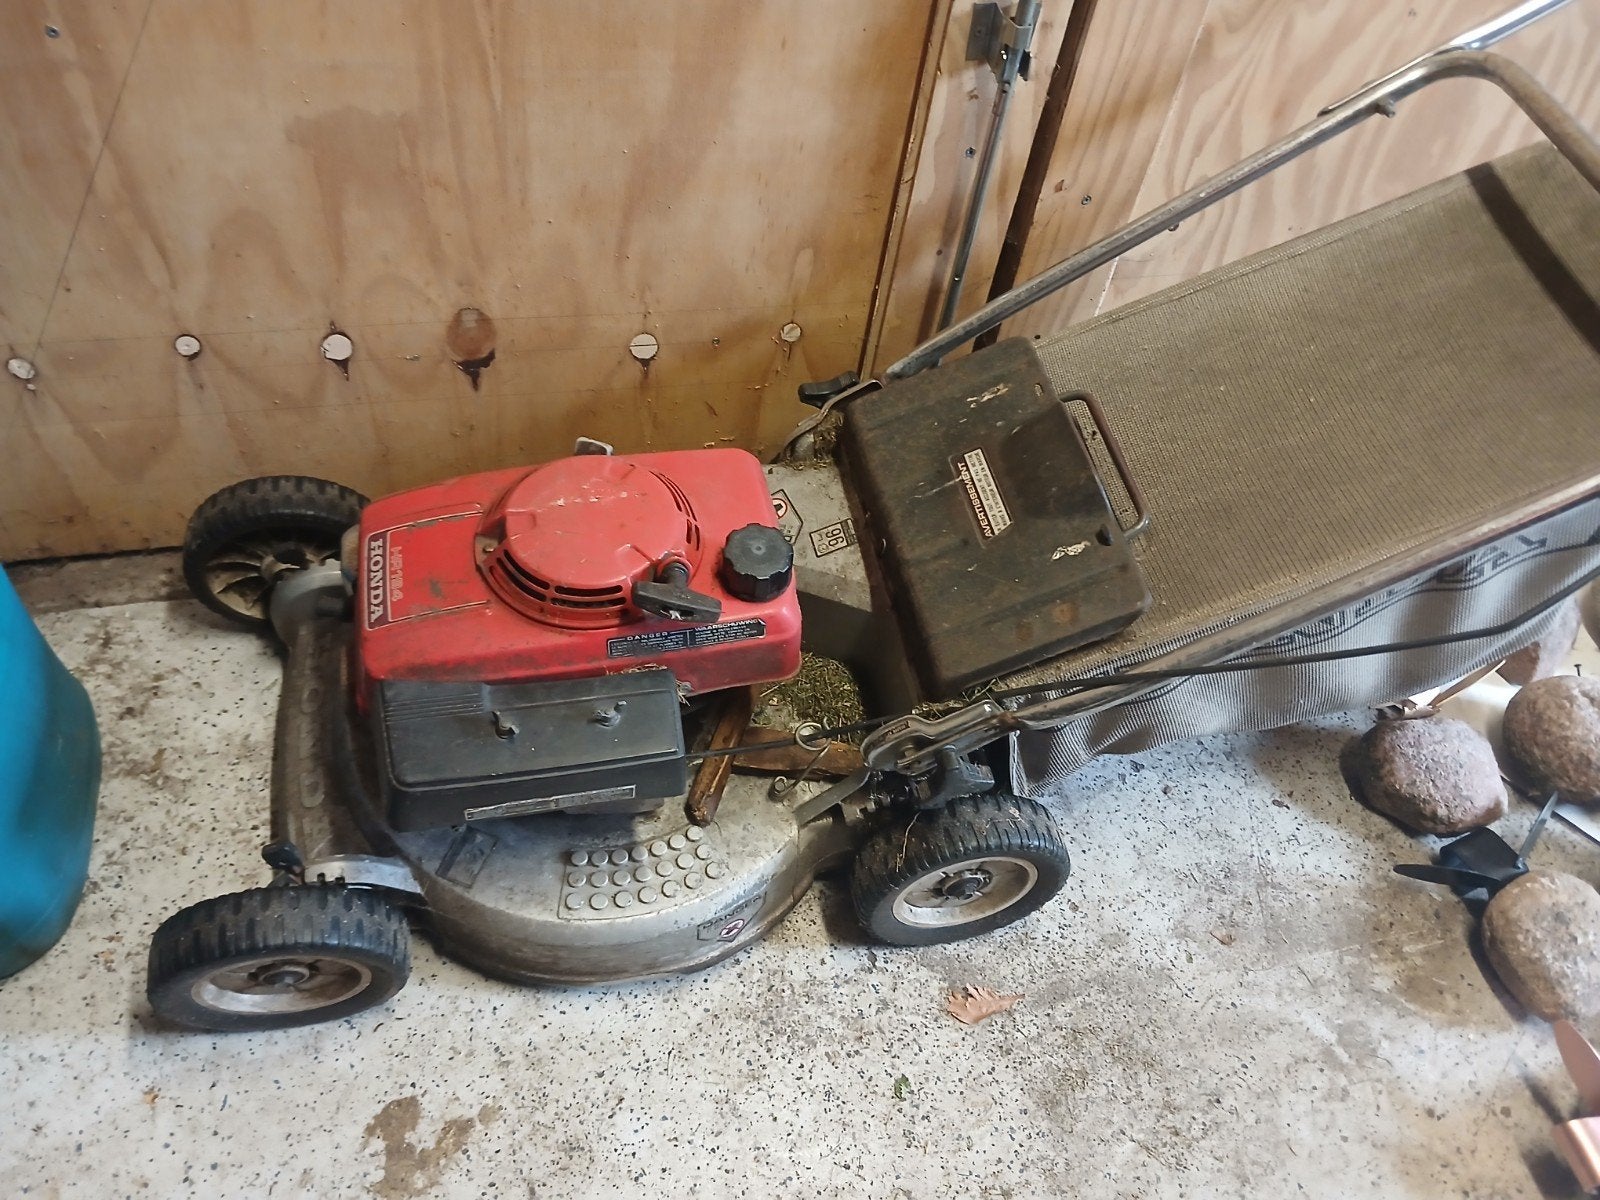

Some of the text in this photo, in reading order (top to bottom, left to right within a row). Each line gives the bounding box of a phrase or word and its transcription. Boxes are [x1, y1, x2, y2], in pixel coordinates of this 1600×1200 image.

[957, 462, 993, 538] AVERTISSEMENT
[370, 538, 384, 622] HONDA
[626, 632, 668, 641] DANGER
[695, 619, 758, 631] WAARSCHUWING
